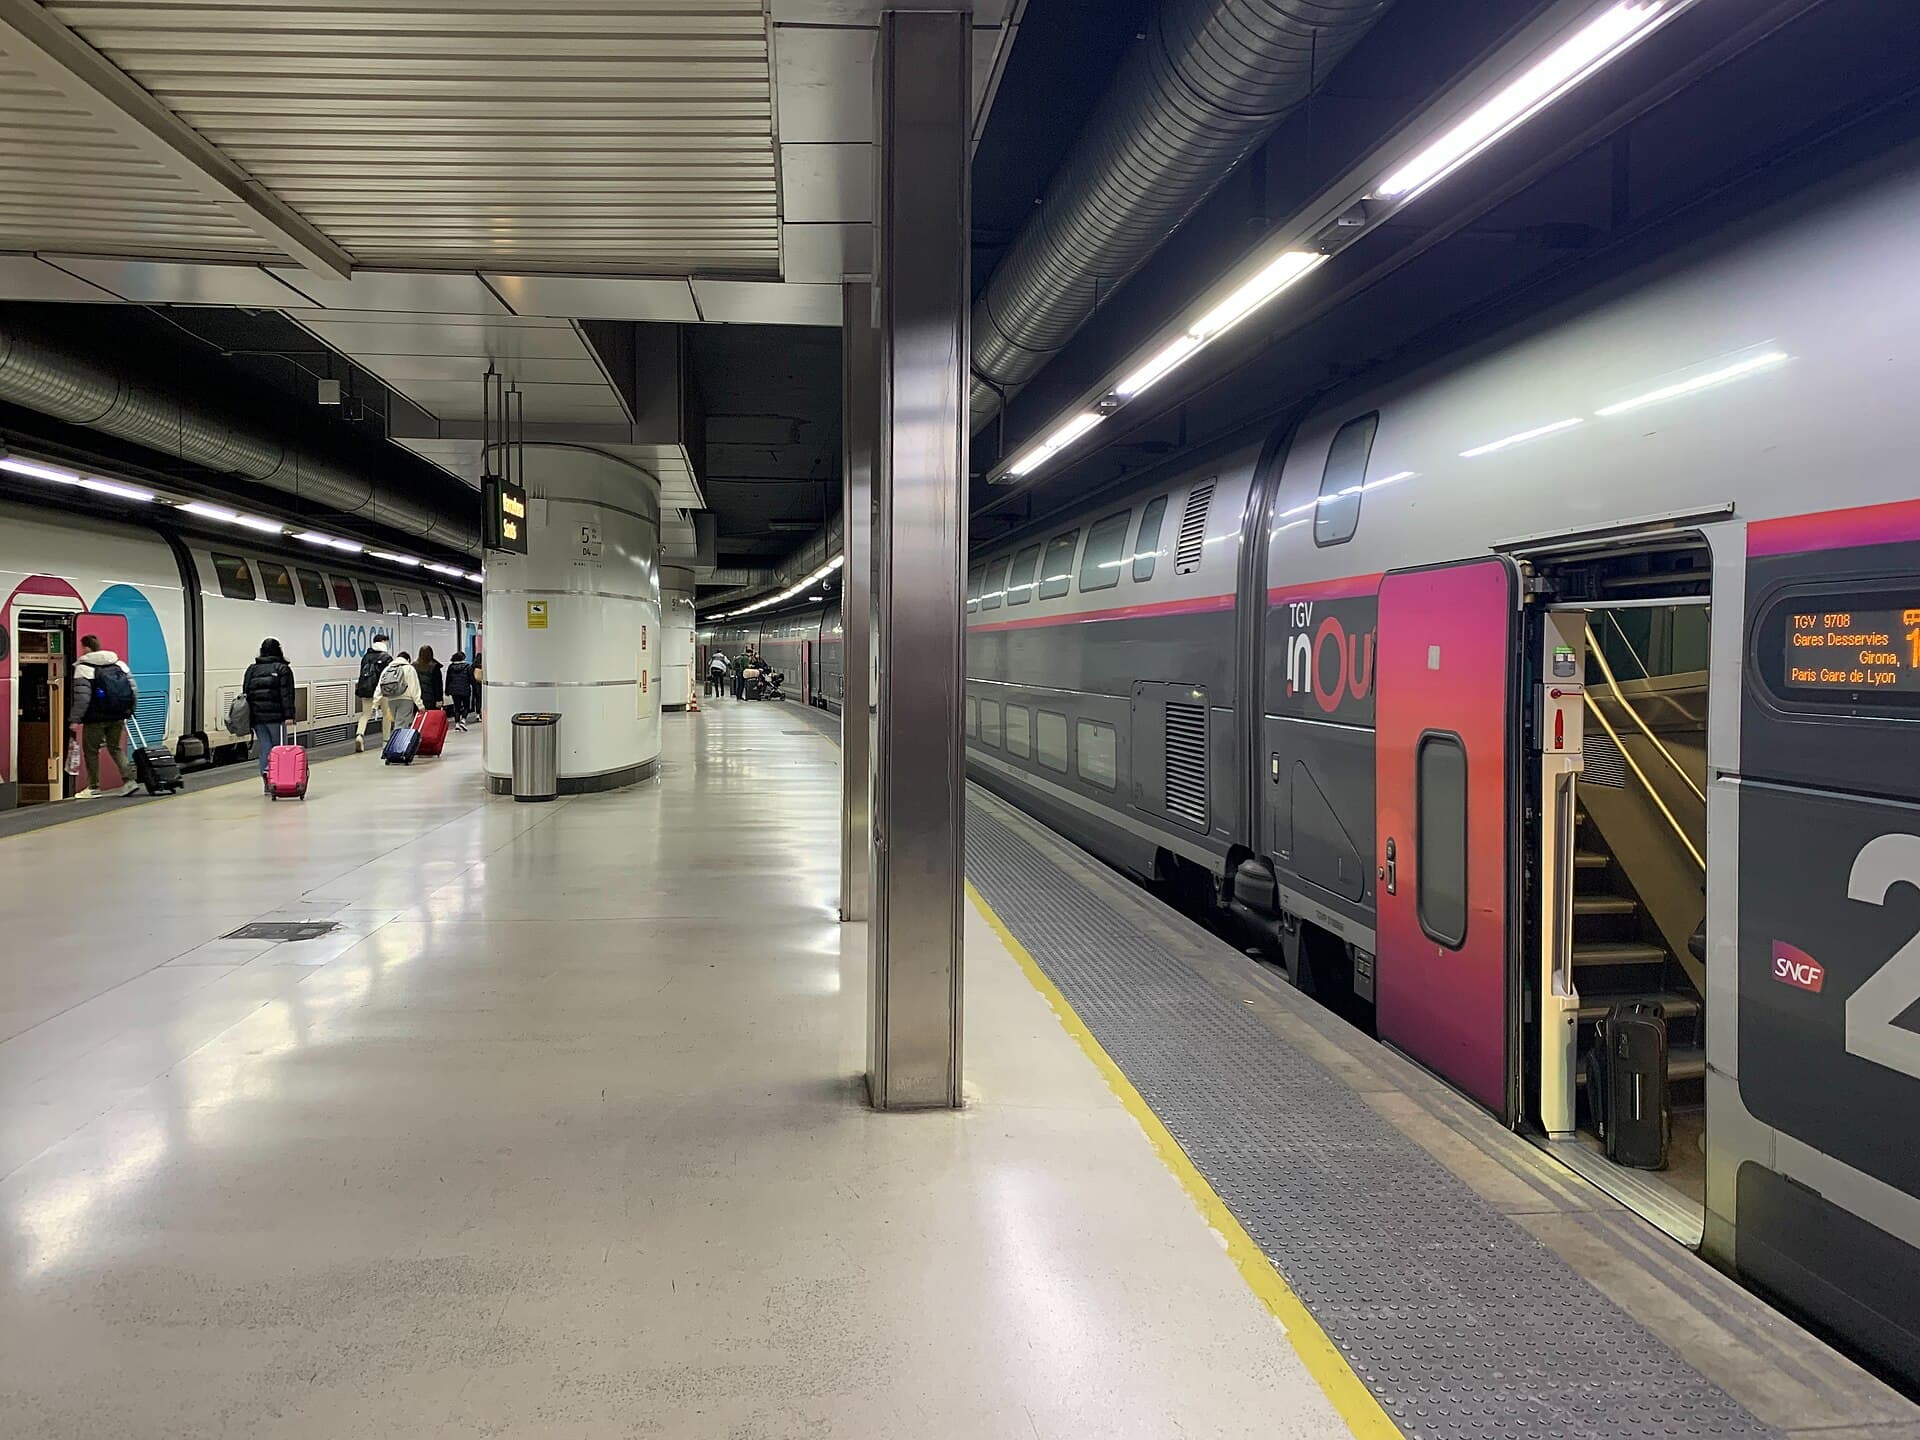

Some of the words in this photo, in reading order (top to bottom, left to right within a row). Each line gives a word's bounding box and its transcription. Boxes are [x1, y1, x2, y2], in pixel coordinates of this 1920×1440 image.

[581, 527, 590, 543] 5
[1289, 602, 1313, 627] TGV
[1794, 615, 1816, 629] TGV
[1824, 614, 1850, 628] 9708
[1793, 633, 1824, 647] Gares
[1828, 632, 1889, 646] Desservies
[1906, 628, 1920, 668] 1
[1286, 616, 1376, 712] inOu
[1859, 650, 1900, 667] Girona,
[1792, 668, 1817, 682] Paris
[1820, 669, 1846, 682] Gare
[1849, 669, 1863, 683] de
[1867, 670, 1896, 686] Lyon
[1845, 833, 1920, 1080] 2
[1774, 958, 1821, 985] SNCF
